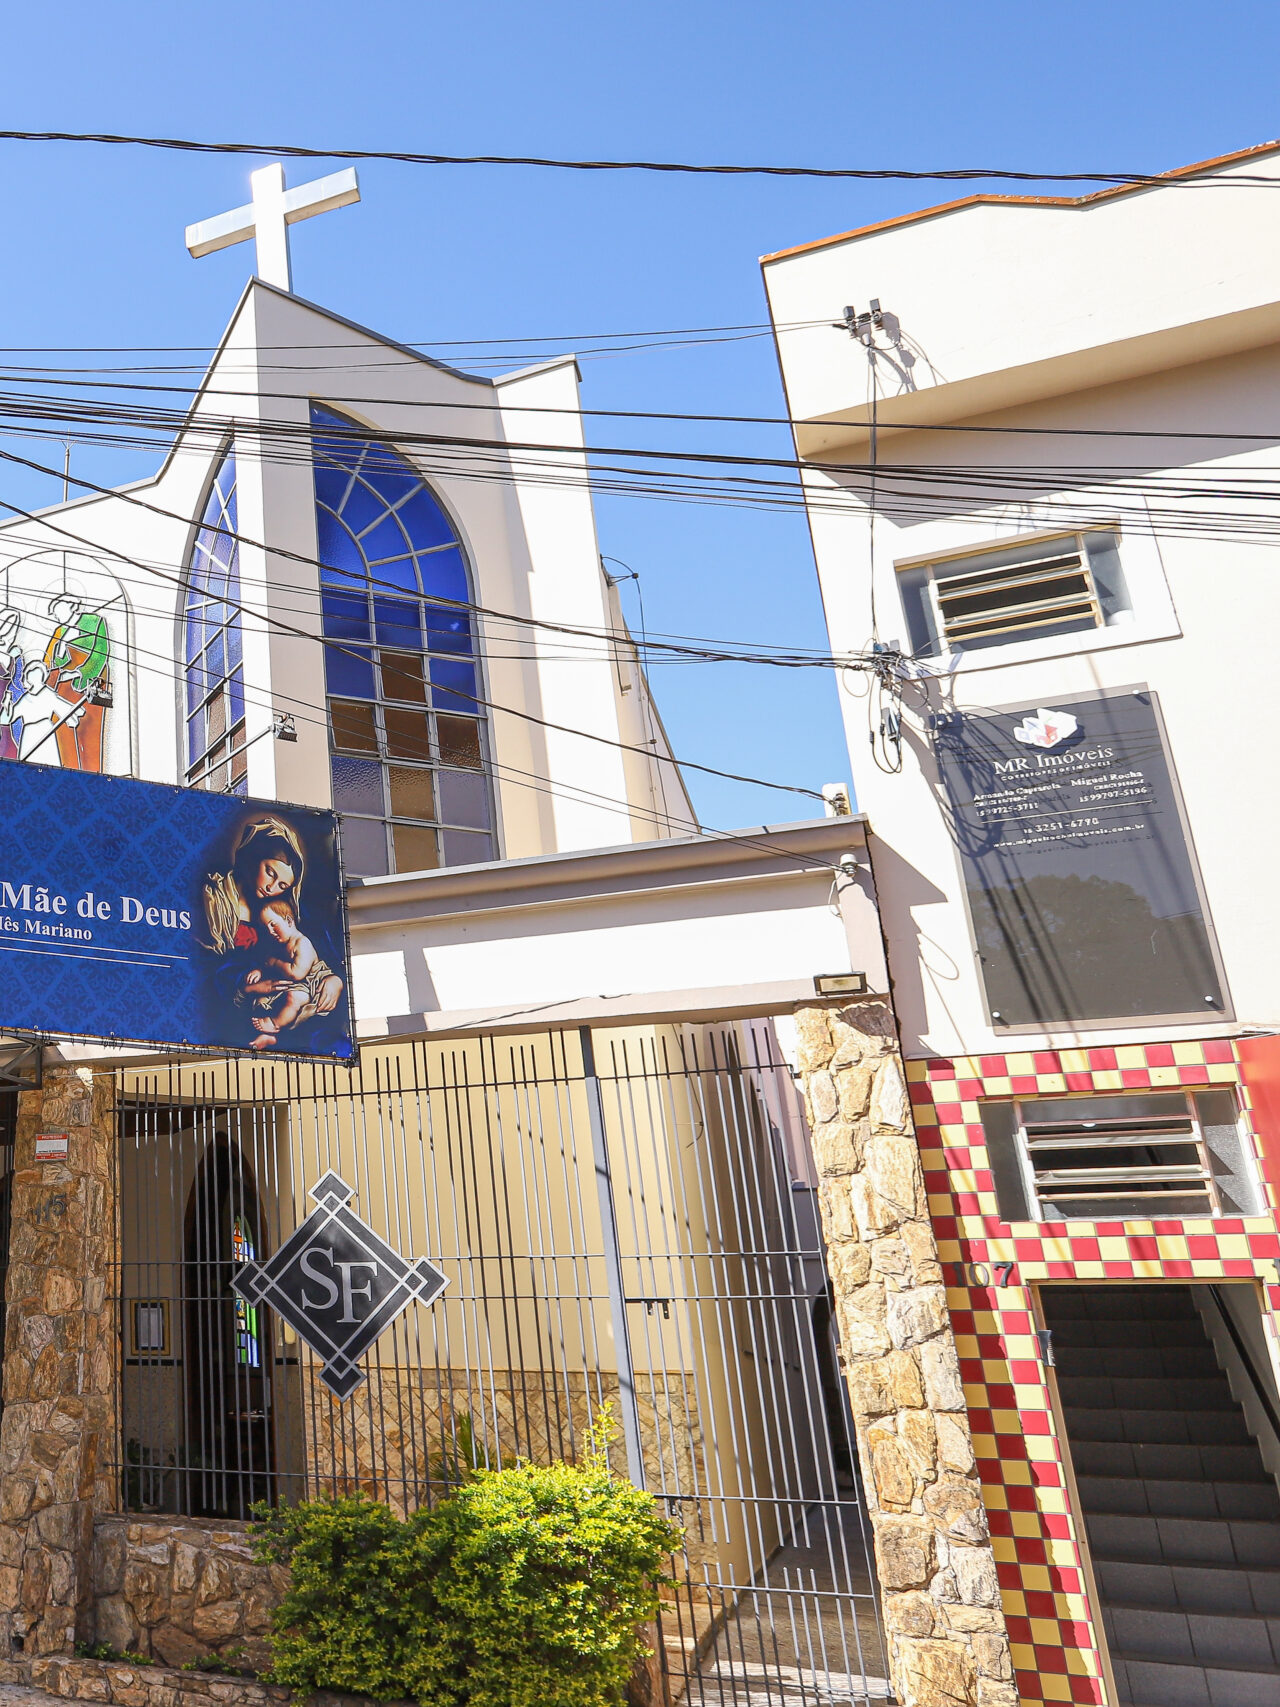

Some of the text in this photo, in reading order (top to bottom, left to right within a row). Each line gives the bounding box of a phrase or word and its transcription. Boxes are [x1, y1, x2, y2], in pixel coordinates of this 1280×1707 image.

[993, 745, 1114, 775] MR Imóveis
[1070, 771, 1144, 788] Miguel Rocha
[0, 881, 67, 915] Mãe
[77, 891, 111, 920] de
[120, 895, 191, 931] Deus
[24, 918, 93, 942] Mariano
[33, 1192, 67, 1224] 115
[299, 1247, 378, 1323] SF
[953, 1261, 1013, 1288] 107
